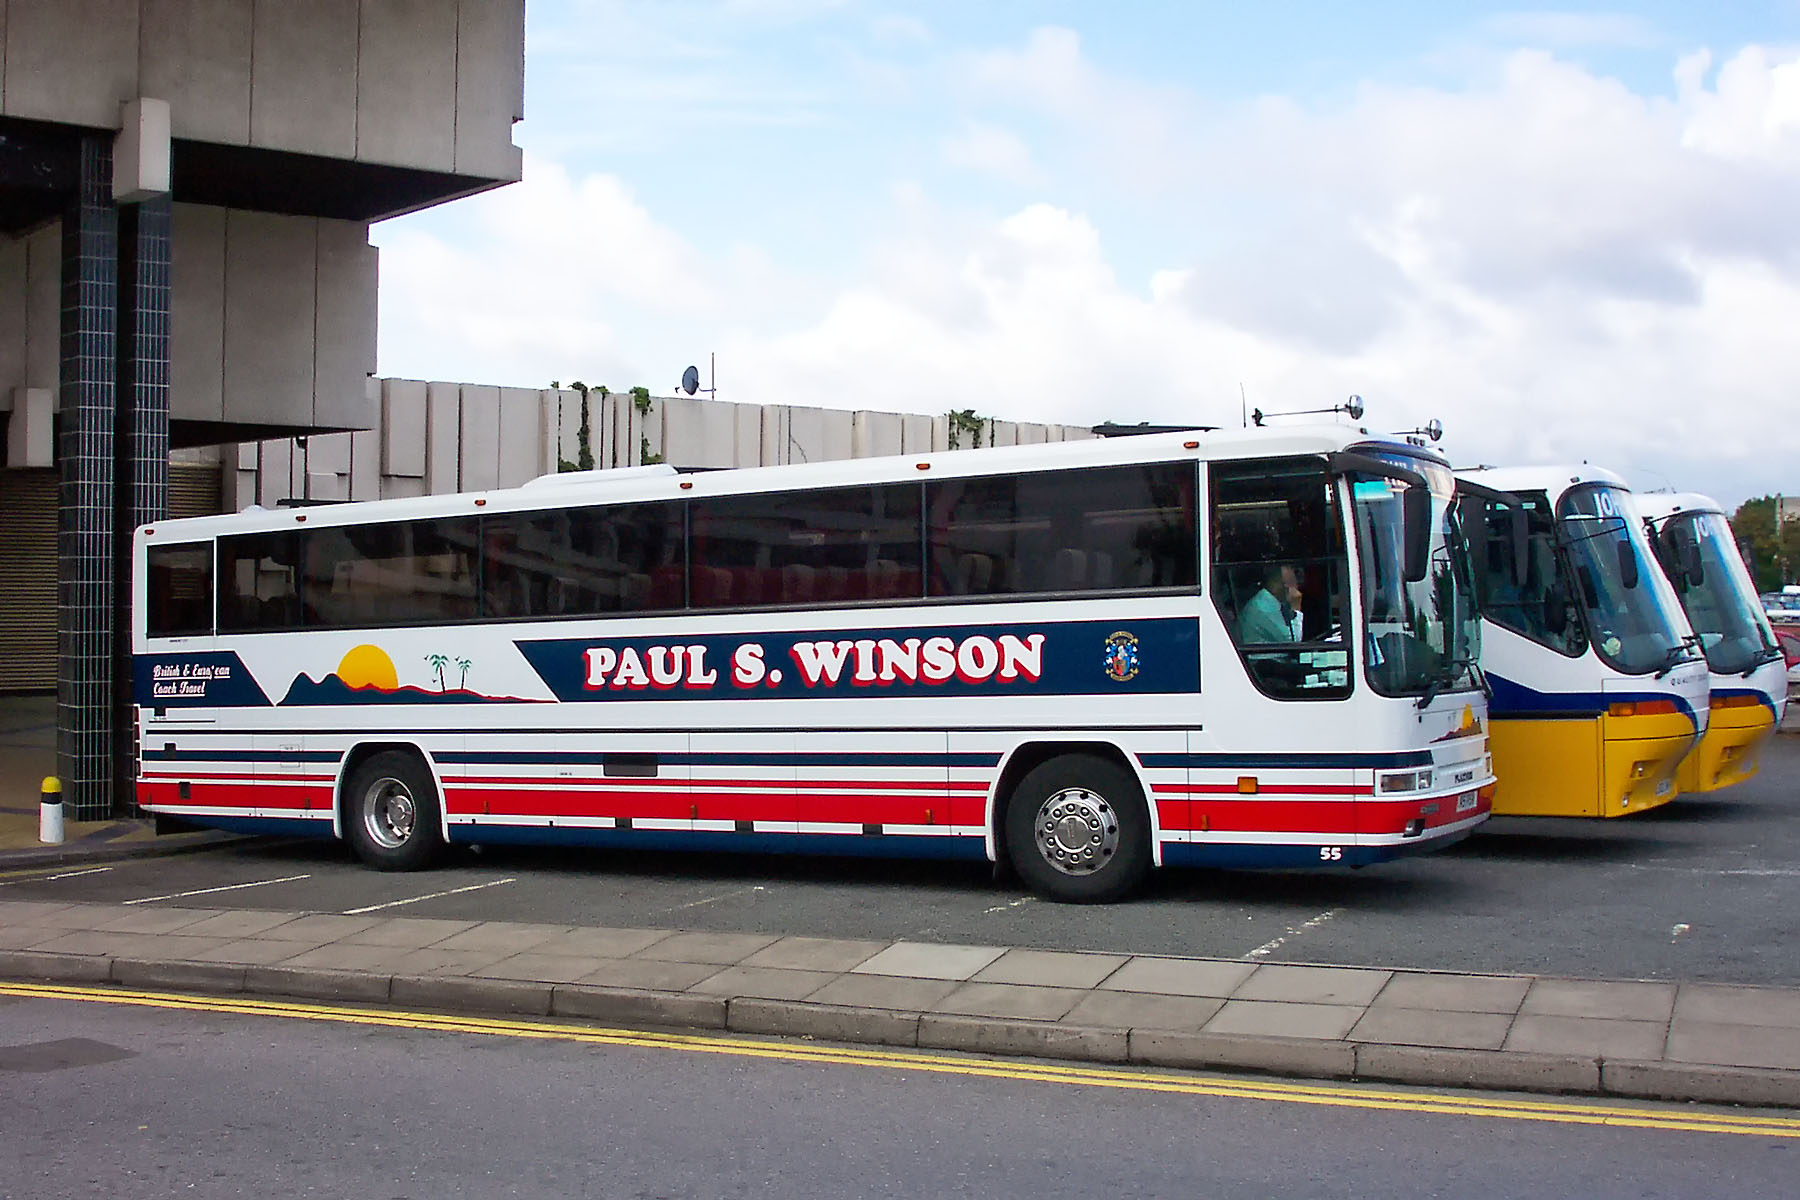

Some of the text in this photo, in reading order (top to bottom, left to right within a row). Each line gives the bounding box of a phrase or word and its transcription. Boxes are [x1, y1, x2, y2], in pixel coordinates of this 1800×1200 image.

[583, 634, 1046, 690] PAUL S. WINSON
[153, 664, 180, 678] British
[183, 664, 190, 676] &
[153, 681, 206, 695] Coach Travel
[1320, 846, 1342, 861] 55
